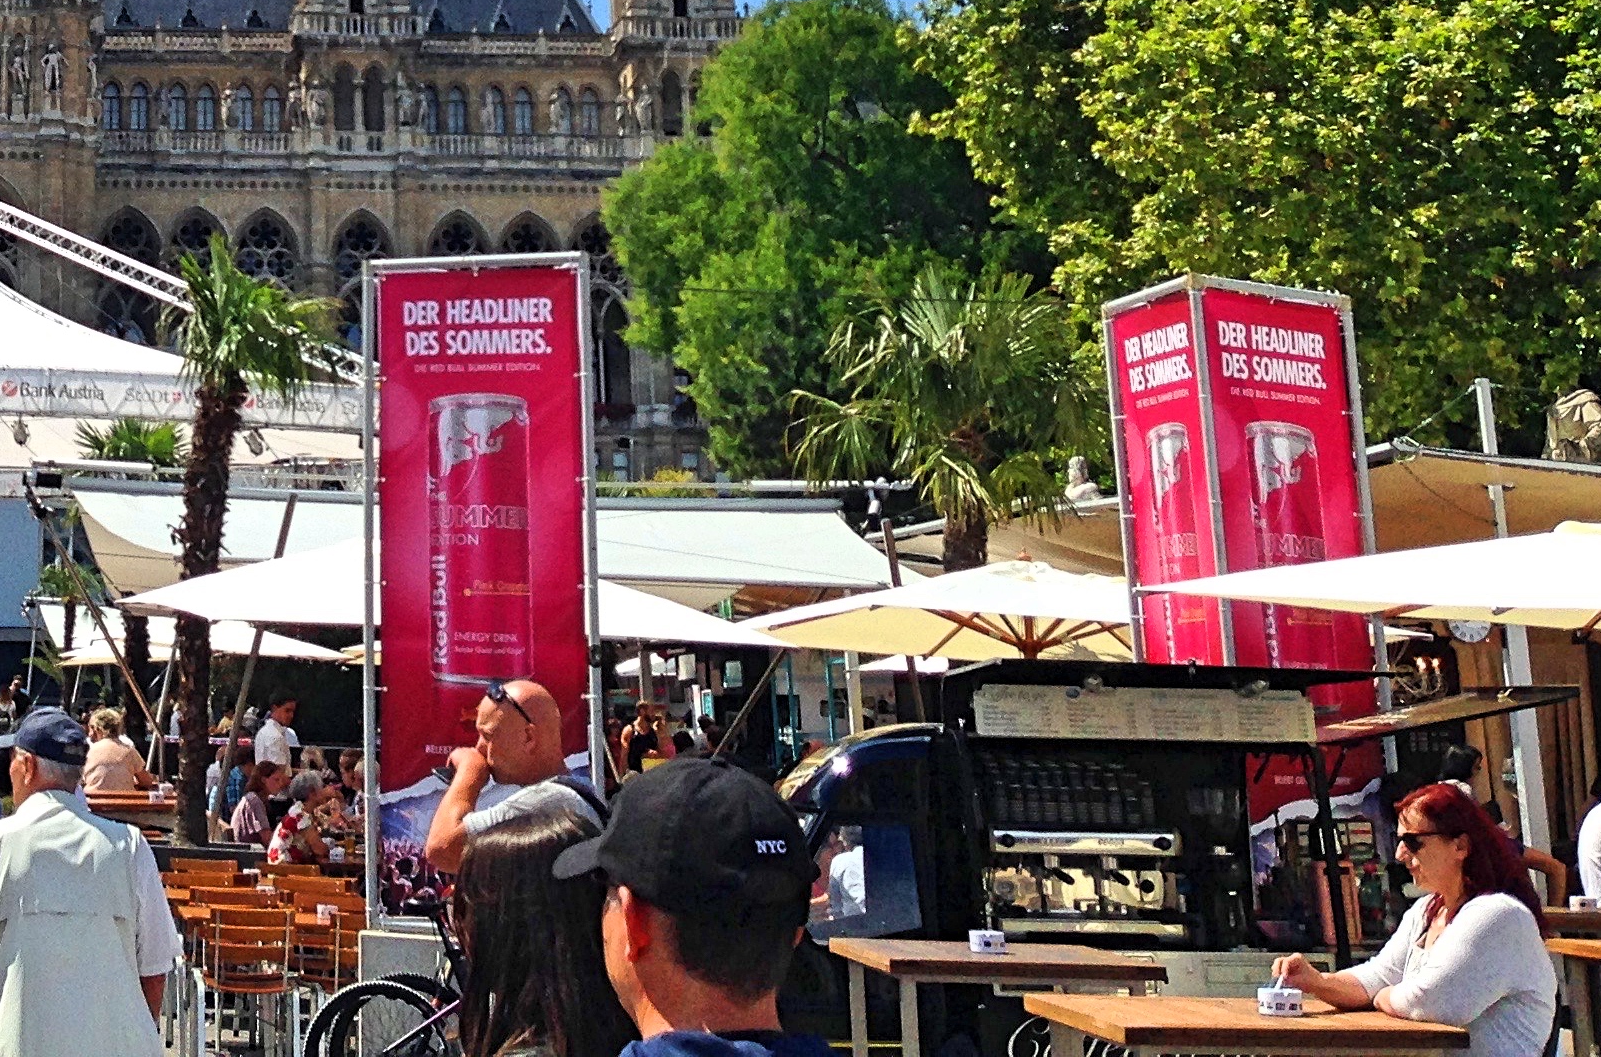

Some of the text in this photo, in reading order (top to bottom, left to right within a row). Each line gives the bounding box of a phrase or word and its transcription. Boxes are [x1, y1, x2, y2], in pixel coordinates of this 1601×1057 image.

[403, 297, 553, 326] DER HEADLINER
[405, 328, 553, 356] DES SOMMERS.
[1125, 322, 1189, 363] DER HEADLINER
[1218, 320, 1326, 359] DER HEADLINER
[1129, 353, 1193, 394] DES SOMMERS.
[1222, 351, 1327, 390] DES SOMMERS.
[19, 382, 105, 401] Bank Austria
[754, 839, 787, 854] NYC
